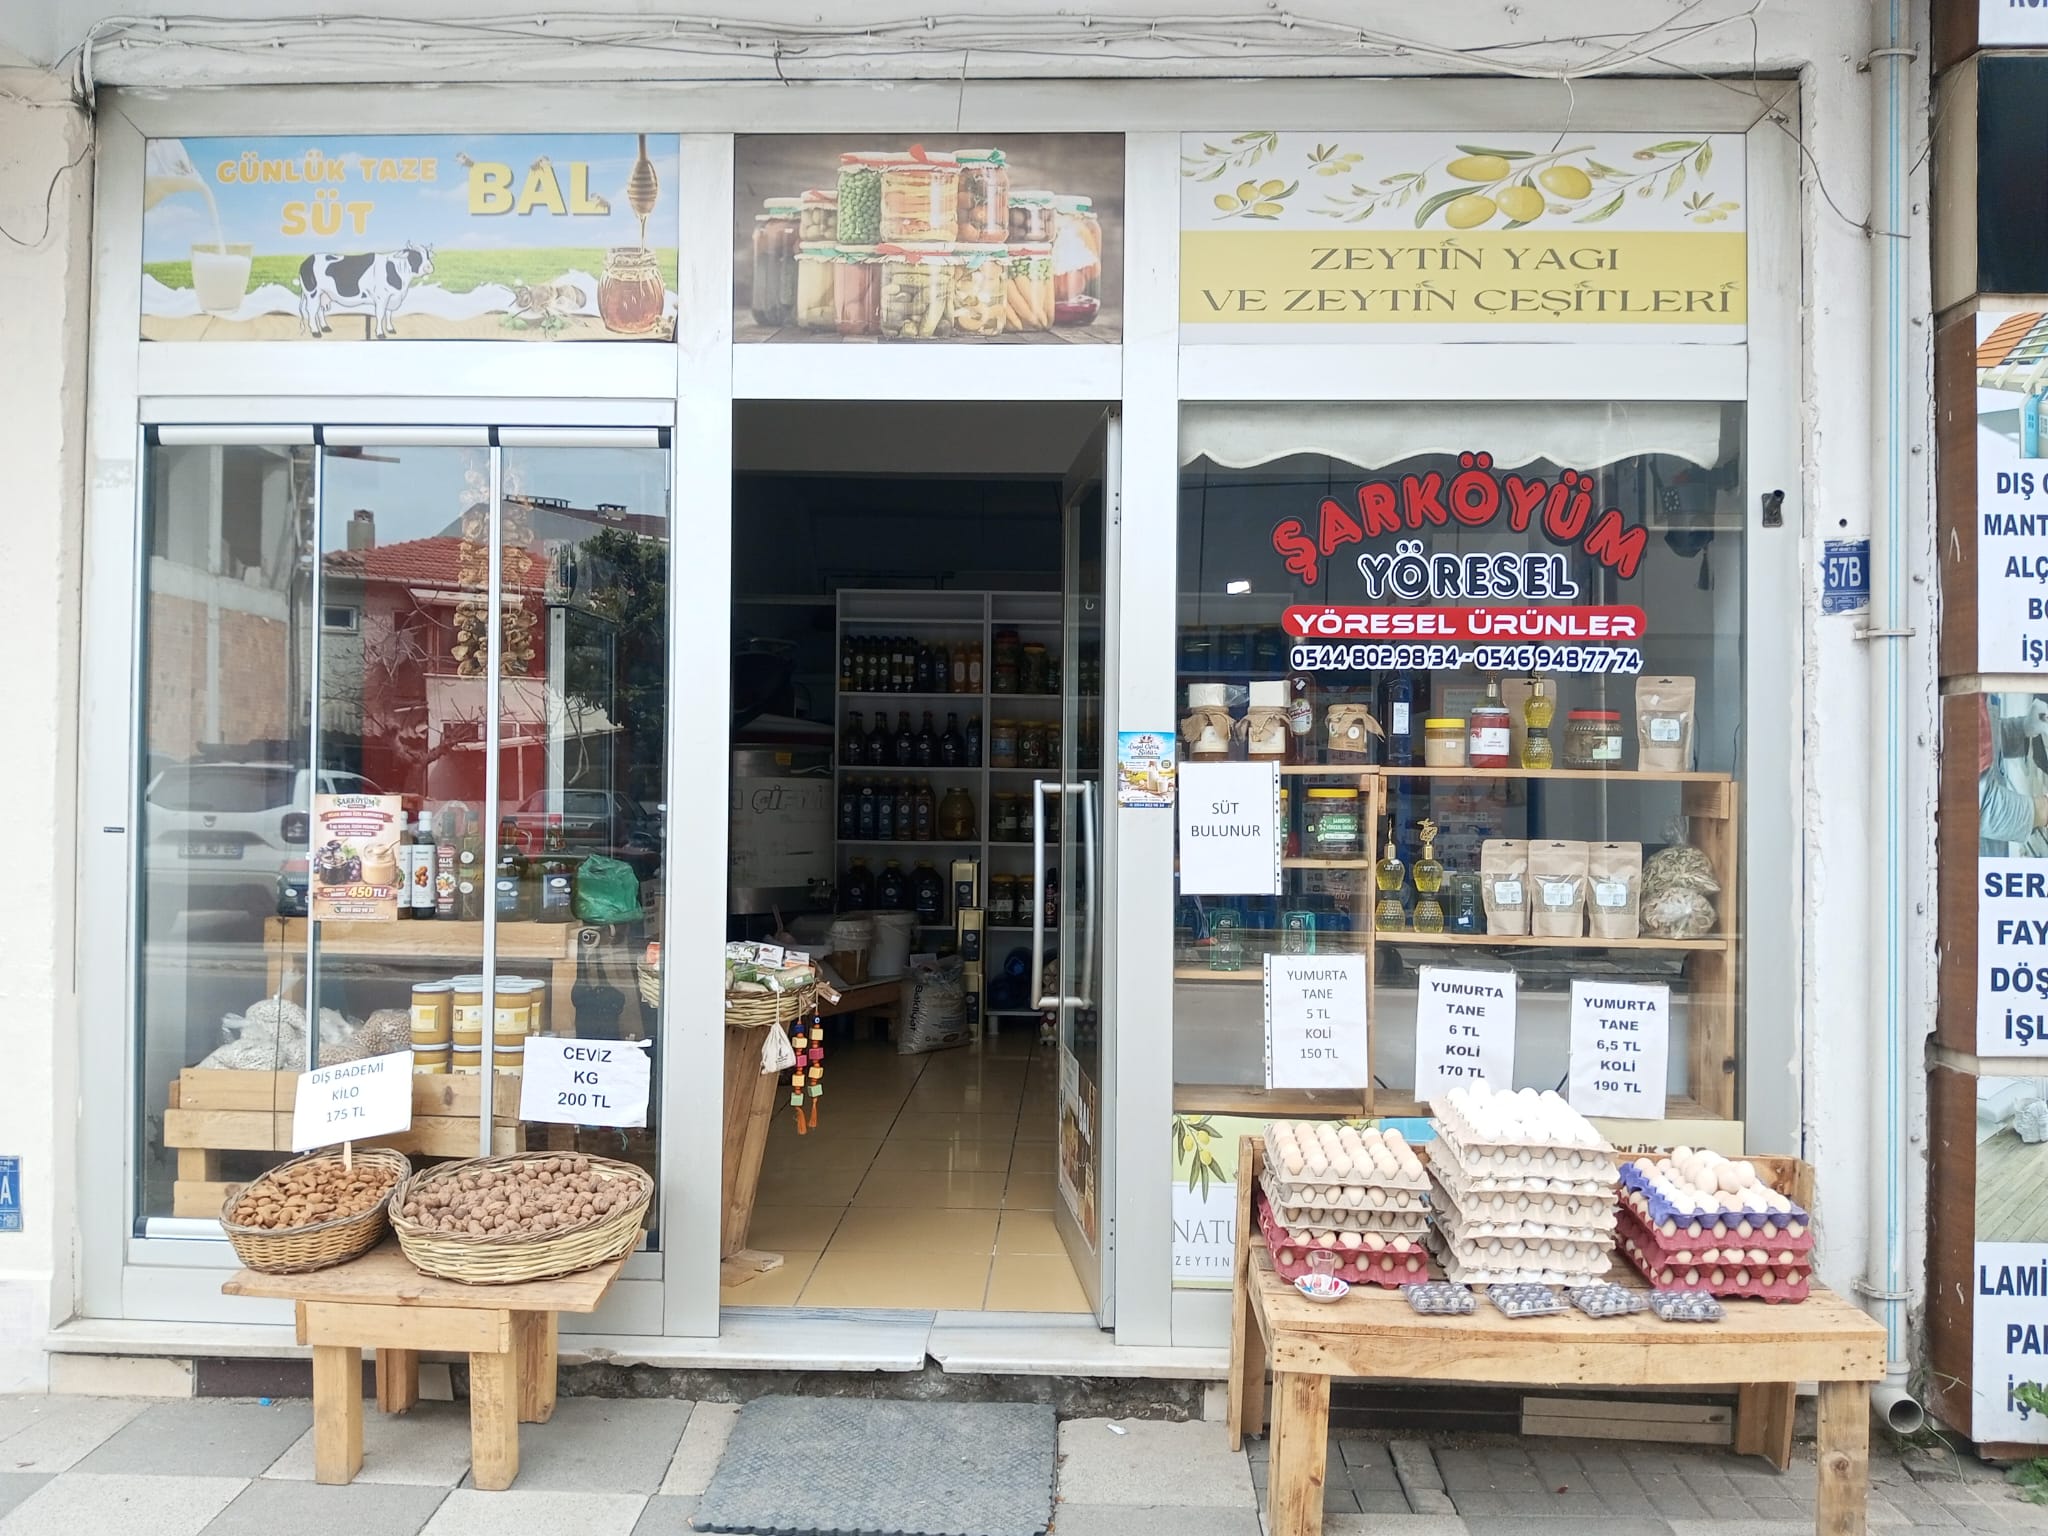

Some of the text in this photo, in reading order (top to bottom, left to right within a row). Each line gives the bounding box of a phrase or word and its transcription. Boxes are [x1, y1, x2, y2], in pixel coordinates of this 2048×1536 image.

[217, 149, 437, 185] GÜNLÜK TAZE
[467, 160, 612, 217] BAL
[280, 189, 376, 237] SÜT
[1310, 237, 1619, 271] ZEYTİN YAGI
[1201, 279, 1741, 317] VE ZEYTİN ÇEŞİTLERİ
[1997, 472, 2035, 501] DIŞ
[1272, 450, 1650, 587] ŞARKÖYÜM
[1358, 540, 1580, 599] YÖRESEL
[1829, 556, 1861, 588] 57B
[2028, 598, 2048, 621] B
[1293, 609, 1637, 637] YÖRESEL ÜRÜNLER
[2022, 633, 2048, 668] İŞ
[1291, 647, 1347, 668] 0544
[1351, 648, 1393, 667] 802
[1397, 648, 1426, 667] 98
[1431, 648, 1459, 667] 34
[1475, 647, 1532, 669] 0546
[1537, 648, 1580, 669] 948
[1585, 649, 1610, 669] 77
[1616, 650, 1640, 671] 74
[1212, 800, 1240, 815] SÜT
[1191, 824, 1261, 838] BULUNUR
[348, 887, 373, 898] 450
[1985, 872, 2048, 898] SER
[1287, 970, 1348, 982] YUMURTA
[1302, 988, 1333, 1000] TANE
[1431, 981, 1504, 998] YUMURTA
[1446, 1004, 1486, 1018] TANE
[1583, 997, 1657, 1012] YUMURTA
[1306, 1008, 1331, 1019] 5 TL
[1305, 1026, 1332, 1039] KOLİ
[1449, 1025, 1480, 1037] 6 TL
[1599, 1019, 1639, 1031] TANE
[1300, 1048, 1339, 1060] 150 TL
[1445, 1044, 1481, 1058] KOLİ
[1596, 1039, 1641, 1053] 6,5 TL
[563, 1046, 612, 1063] CEVİZ
[334, 1060, 384, 1080] BADEMİ
[1438, 1065, 1485, 1079] 170 TL
[1600, 1060, 1636, 1073] KOLİ
[574, 1071, 598, 1085] KG
[332, 1086, 359, 1101] KİLO
[1593, 1080, 1642, 1094] 190 TL
[558, 1092, 611, 1109] 200 TL
[327, 1106, 366, 1123] 175 TL
